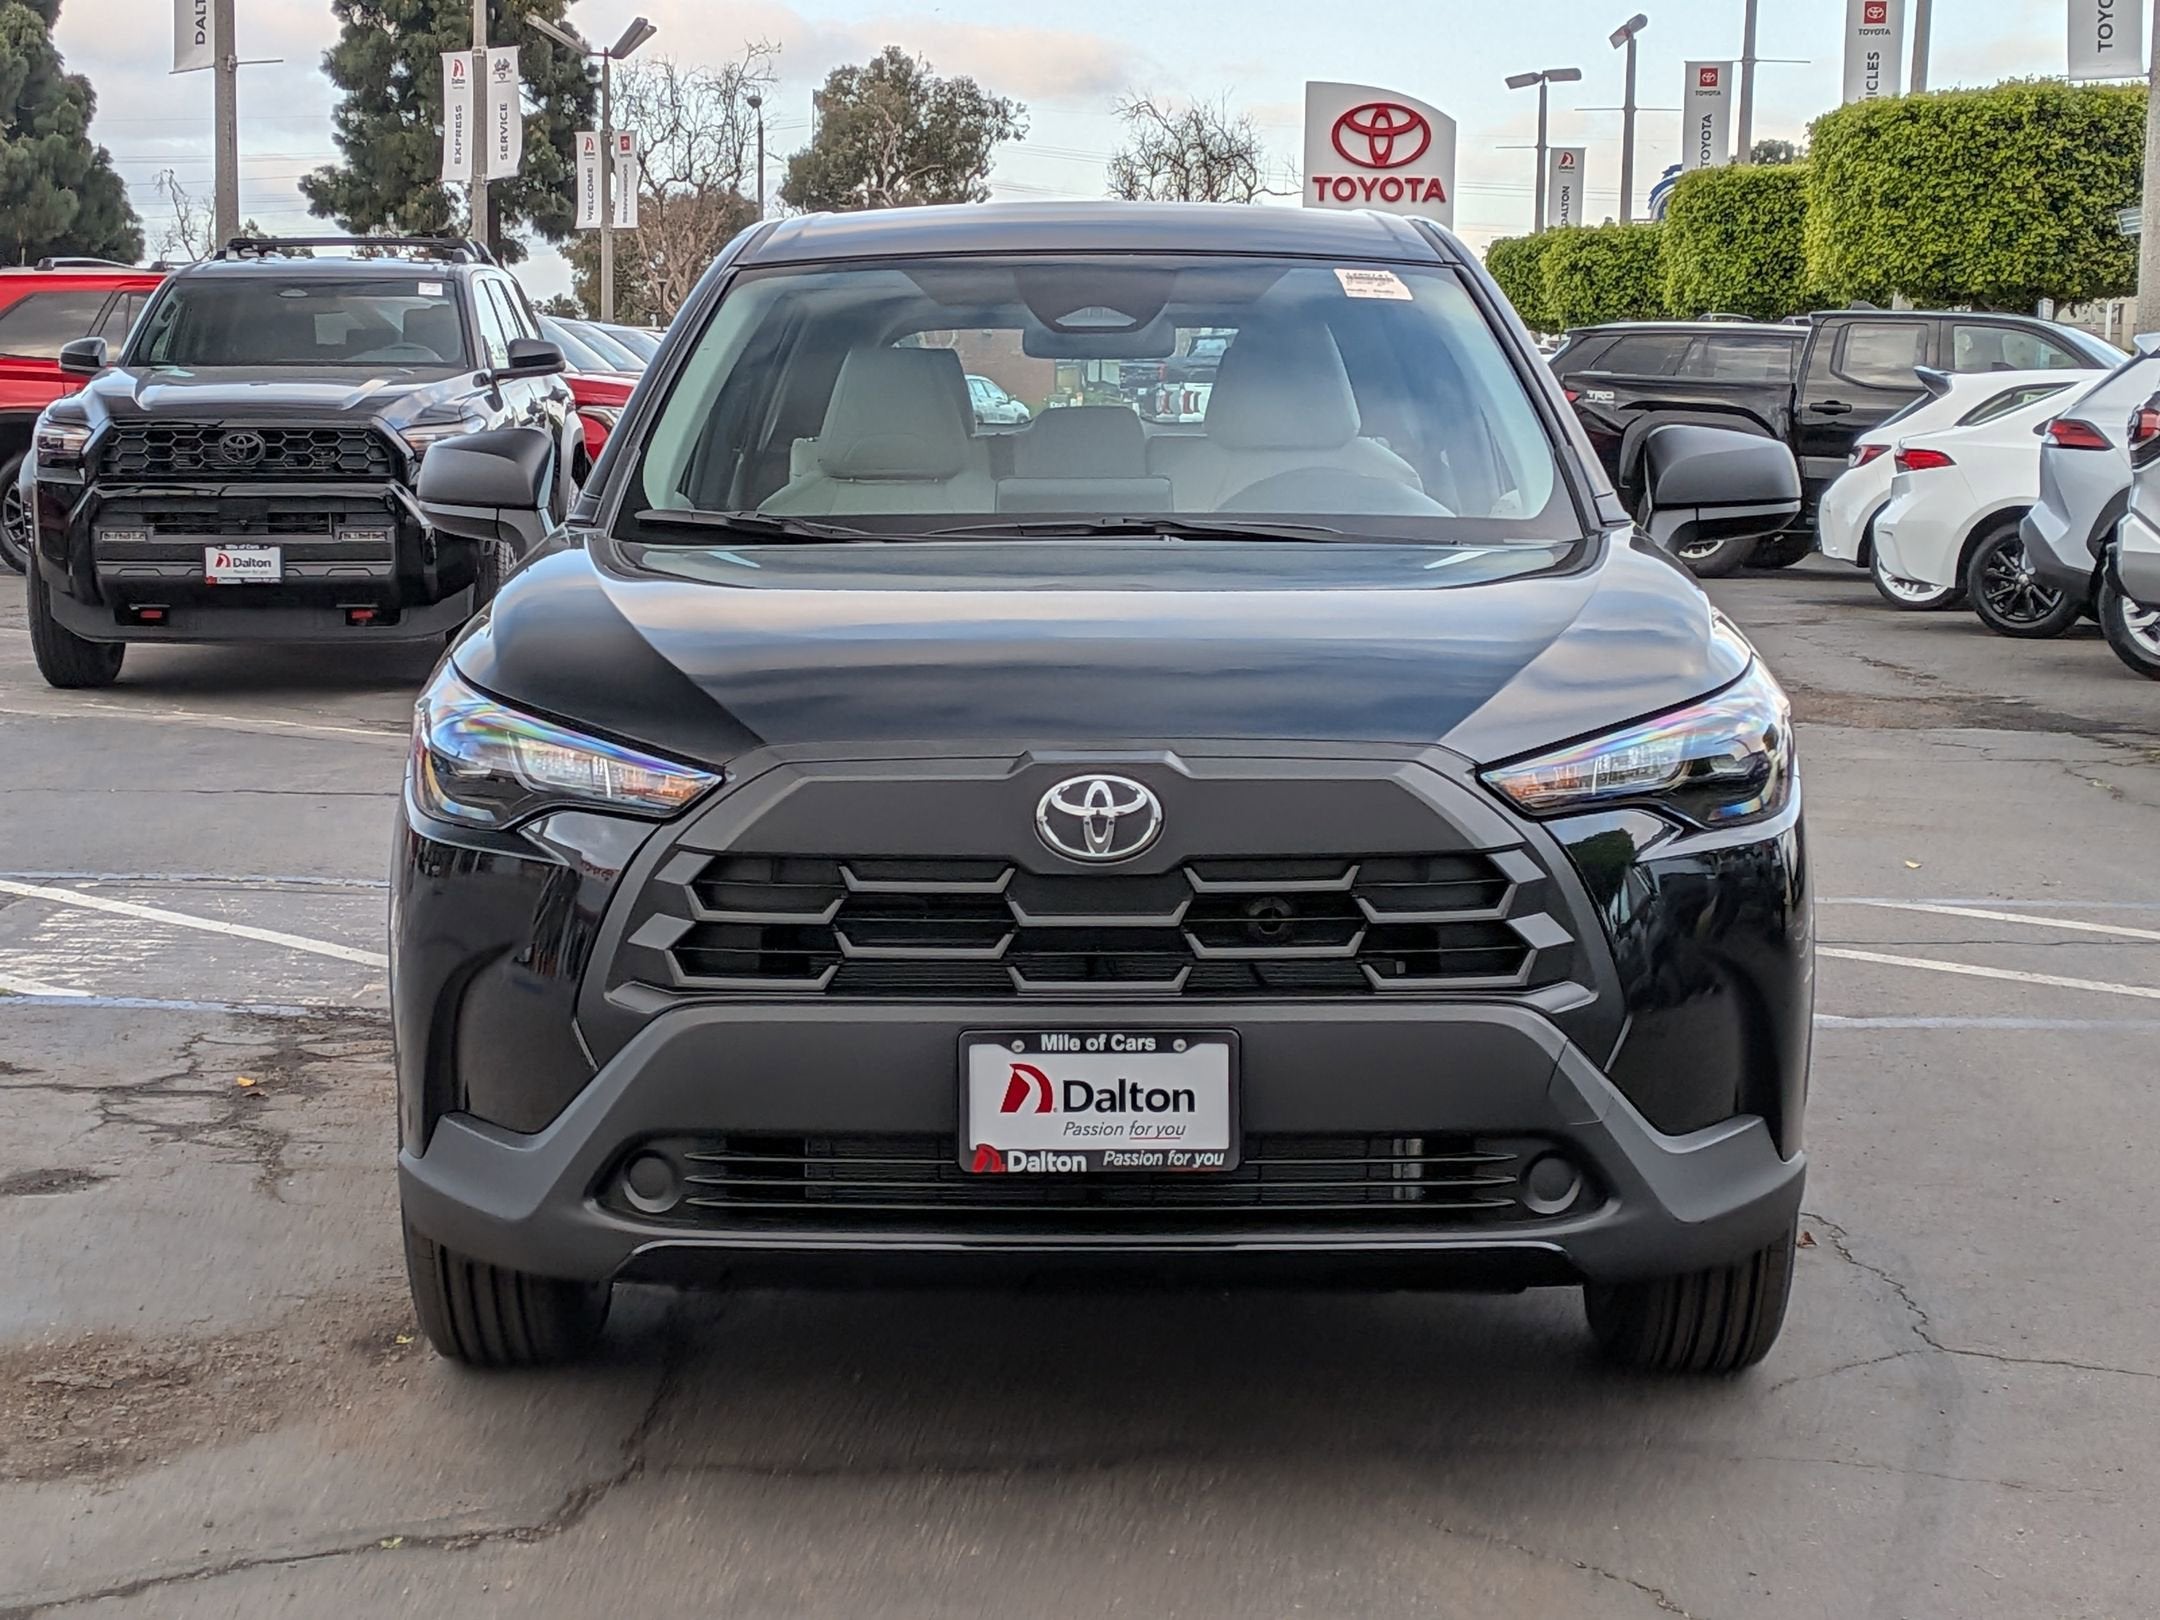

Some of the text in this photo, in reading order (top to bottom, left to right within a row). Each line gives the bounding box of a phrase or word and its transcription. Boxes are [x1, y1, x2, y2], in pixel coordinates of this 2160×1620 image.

[1858, 28, 1891, 36] TOYOTA
[1866, 51, 1880, 99] ICLES
[454, 104, 463, 165] EXPRESS
[499, 103, 508, 160] SERVICE
[1700, 113, 1712, 168] TOYOTA
[586, 167, 594, 221] WELCOME
[1312, 176, 1446, 203] TOYOTA
[1561, 185, 1570, 226] DALTON
[233, 557, 272, 568] Dalton
[1041, 1034, 1156, 1051] Mile of Cars
[1062, 1078, 1196, 1113] Dalton
[1063, 1120, 1186, 1138] Passion for you
[1008, 1150, 1087, 1173] Dalton
[1102, 1150, 1225, 1168] Passion for you
